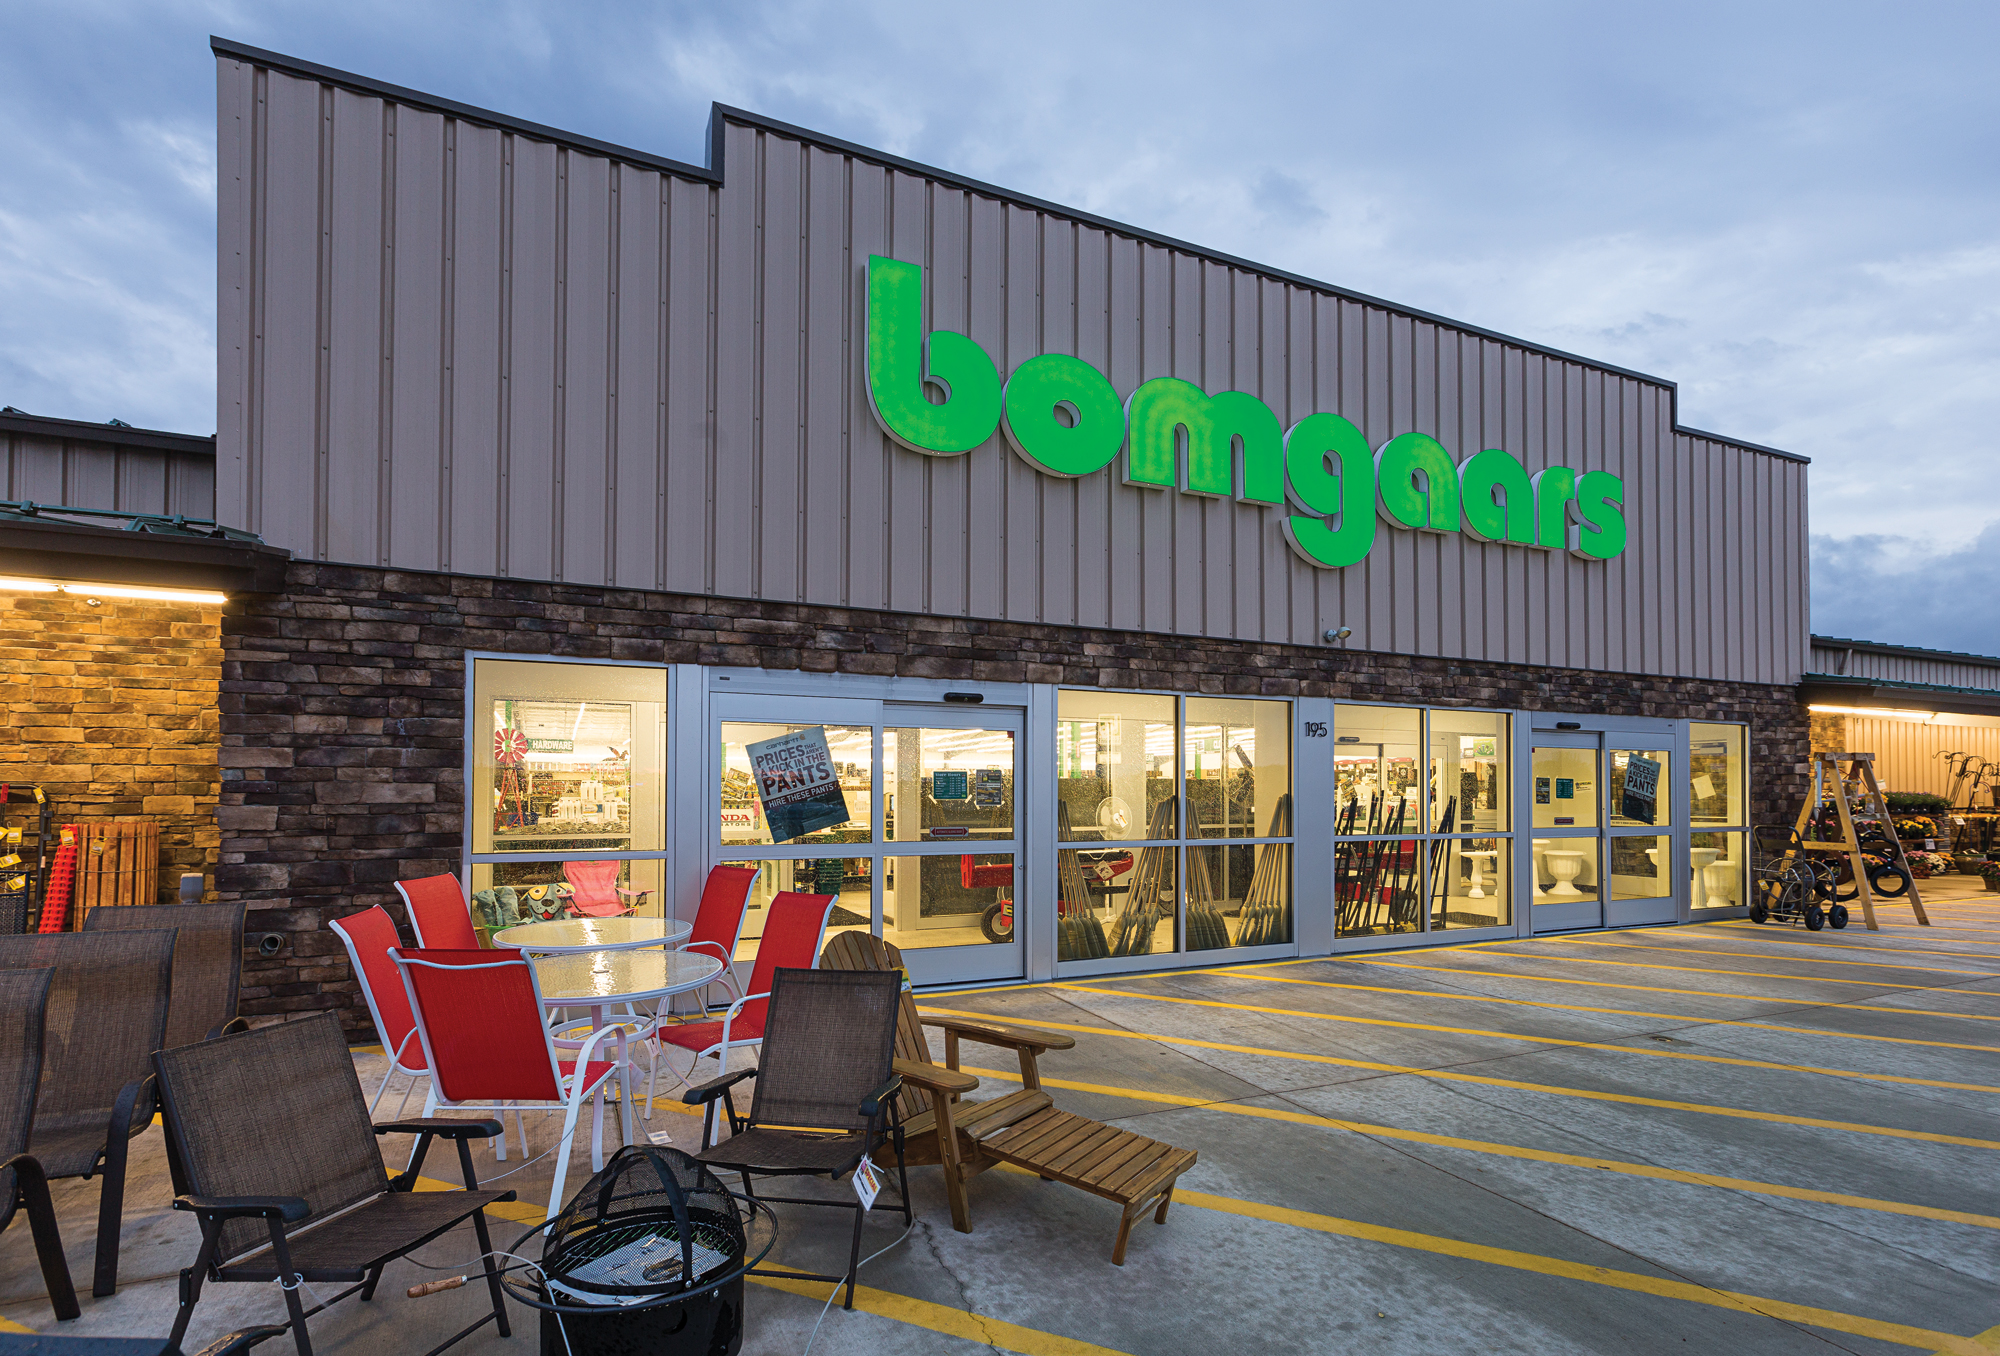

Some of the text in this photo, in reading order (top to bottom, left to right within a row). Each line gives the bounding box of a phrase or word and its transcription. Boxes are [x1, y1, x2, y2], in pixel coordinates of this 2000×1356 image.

[865, 255, 1626, 568] bomgaars
[1305, 721, 1328, 738] 195
[532, 740, 572, 750] HARDWARE
[766, 737, 799, 750] carhartt
[755, 745, 805, 768] PRICES
[761, 752, 826, 777] A KICK IN THE
[1630, 761, 1650, 775] PRICES
[762, 762, 831, 797] PANTS
[1627, 775, 1656, 796] PANTS
[769, 797, 787, 808] HIRE
[787, 790, 811, 802] THESE
[811, 783, 834, 796] PANTS
